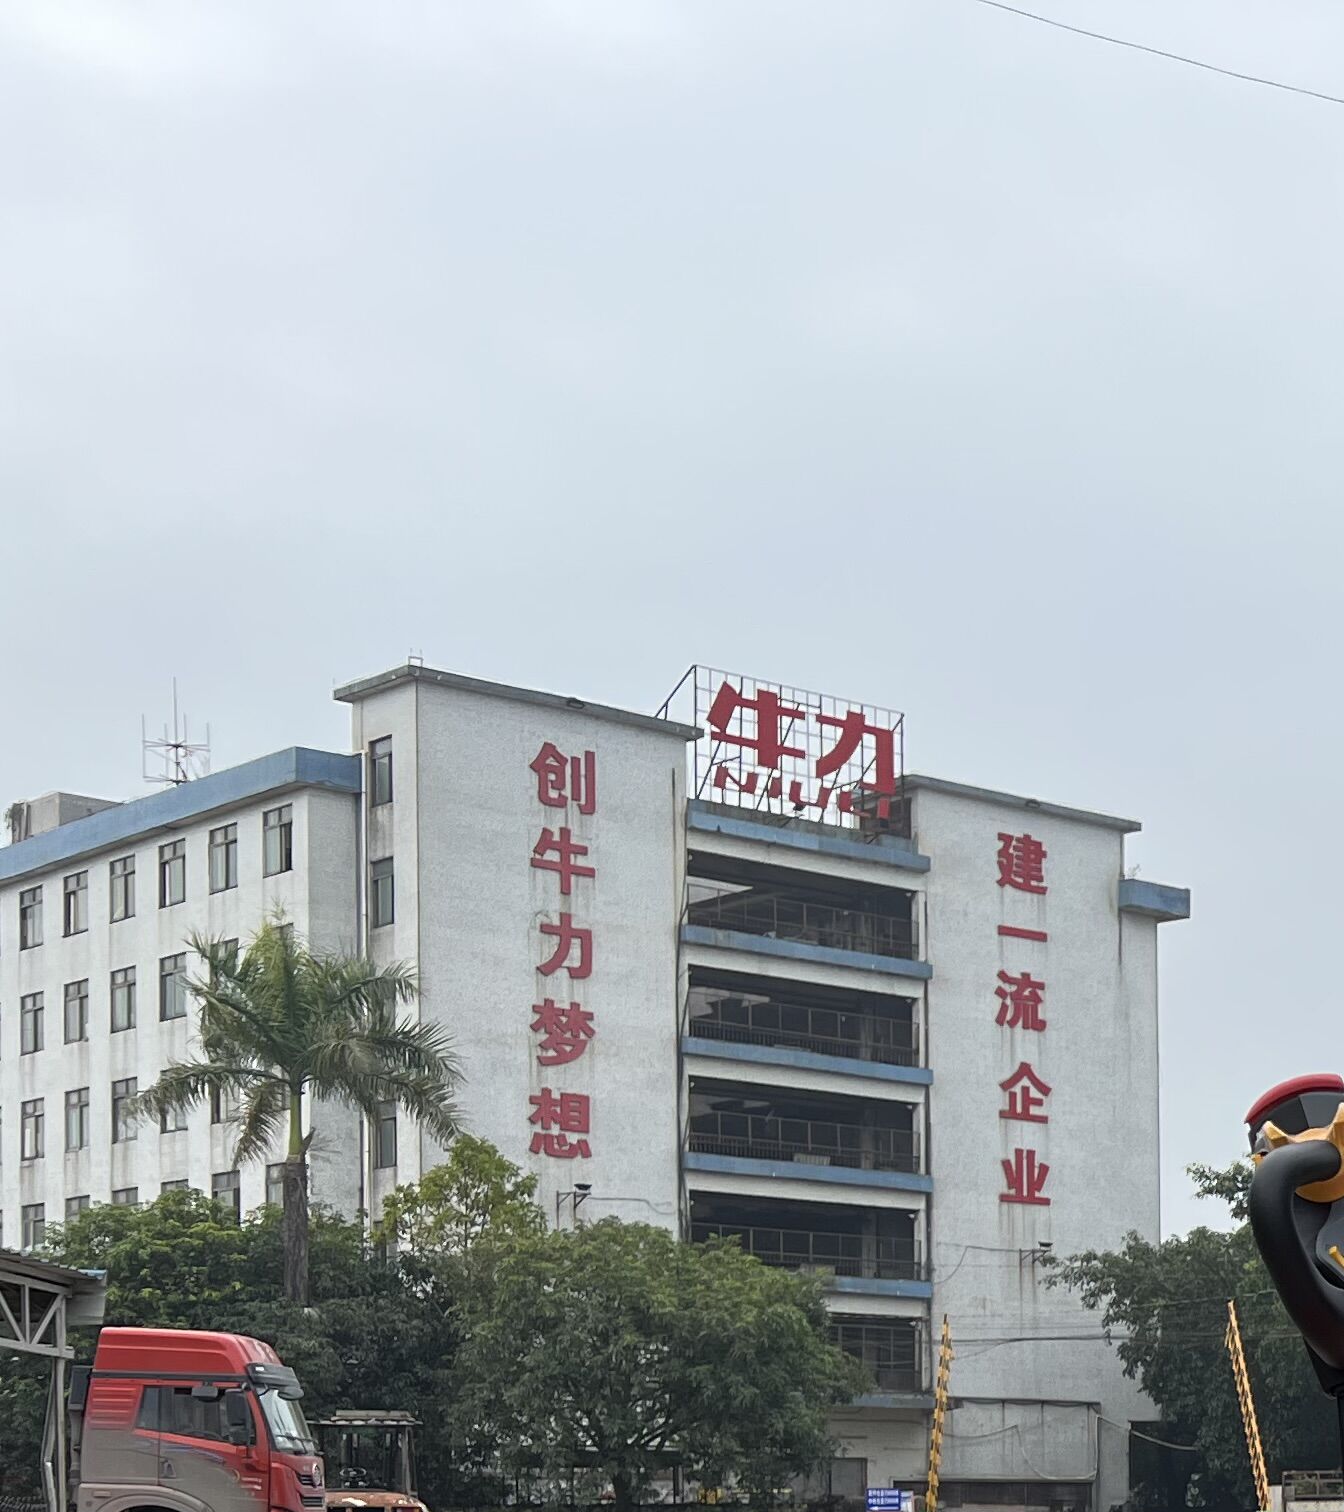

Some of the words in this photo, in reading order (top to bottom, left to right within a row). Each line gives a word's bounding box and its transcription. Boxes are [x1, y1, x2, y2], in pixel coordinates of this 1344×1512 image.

[707, 681, 897, 796] 牛力
[529, 742, 597, 1159] 创牛力梦想
[995, 832, 1052, 1207] 建一流企业
